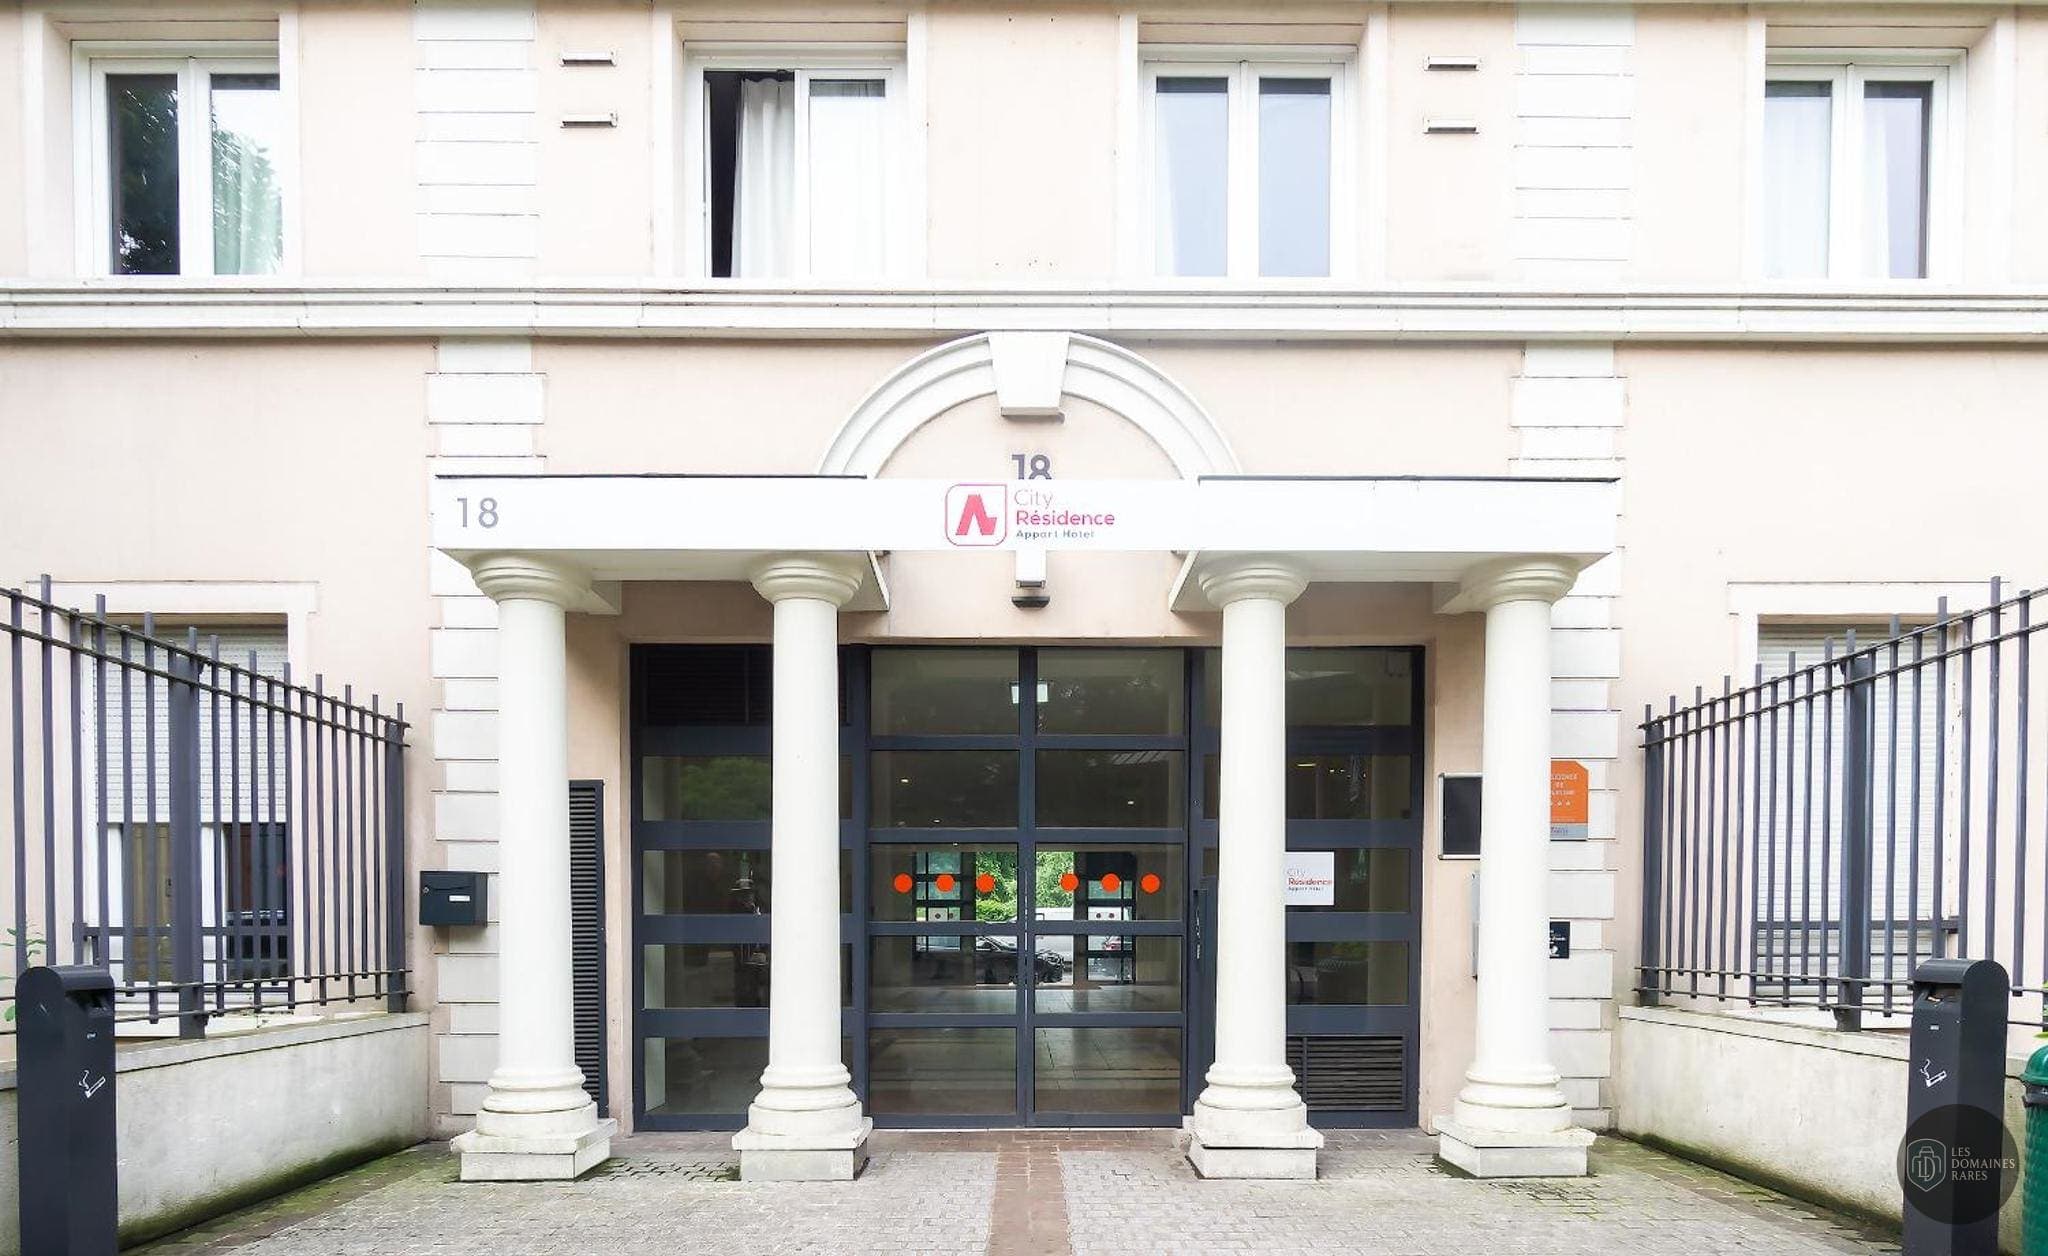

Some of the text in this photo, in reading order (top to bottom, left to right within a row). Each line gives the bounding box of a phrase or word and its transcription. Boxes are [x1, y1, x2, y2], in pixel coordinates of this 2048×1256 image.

[1011, 454, 1052, 480] 18
[1014, 489, 1053, 510] City
[457, 497, 499, 529] 18
[1016, 510, 1115, 526] Résidence
[1016, 530, 1058, 540] Appart
